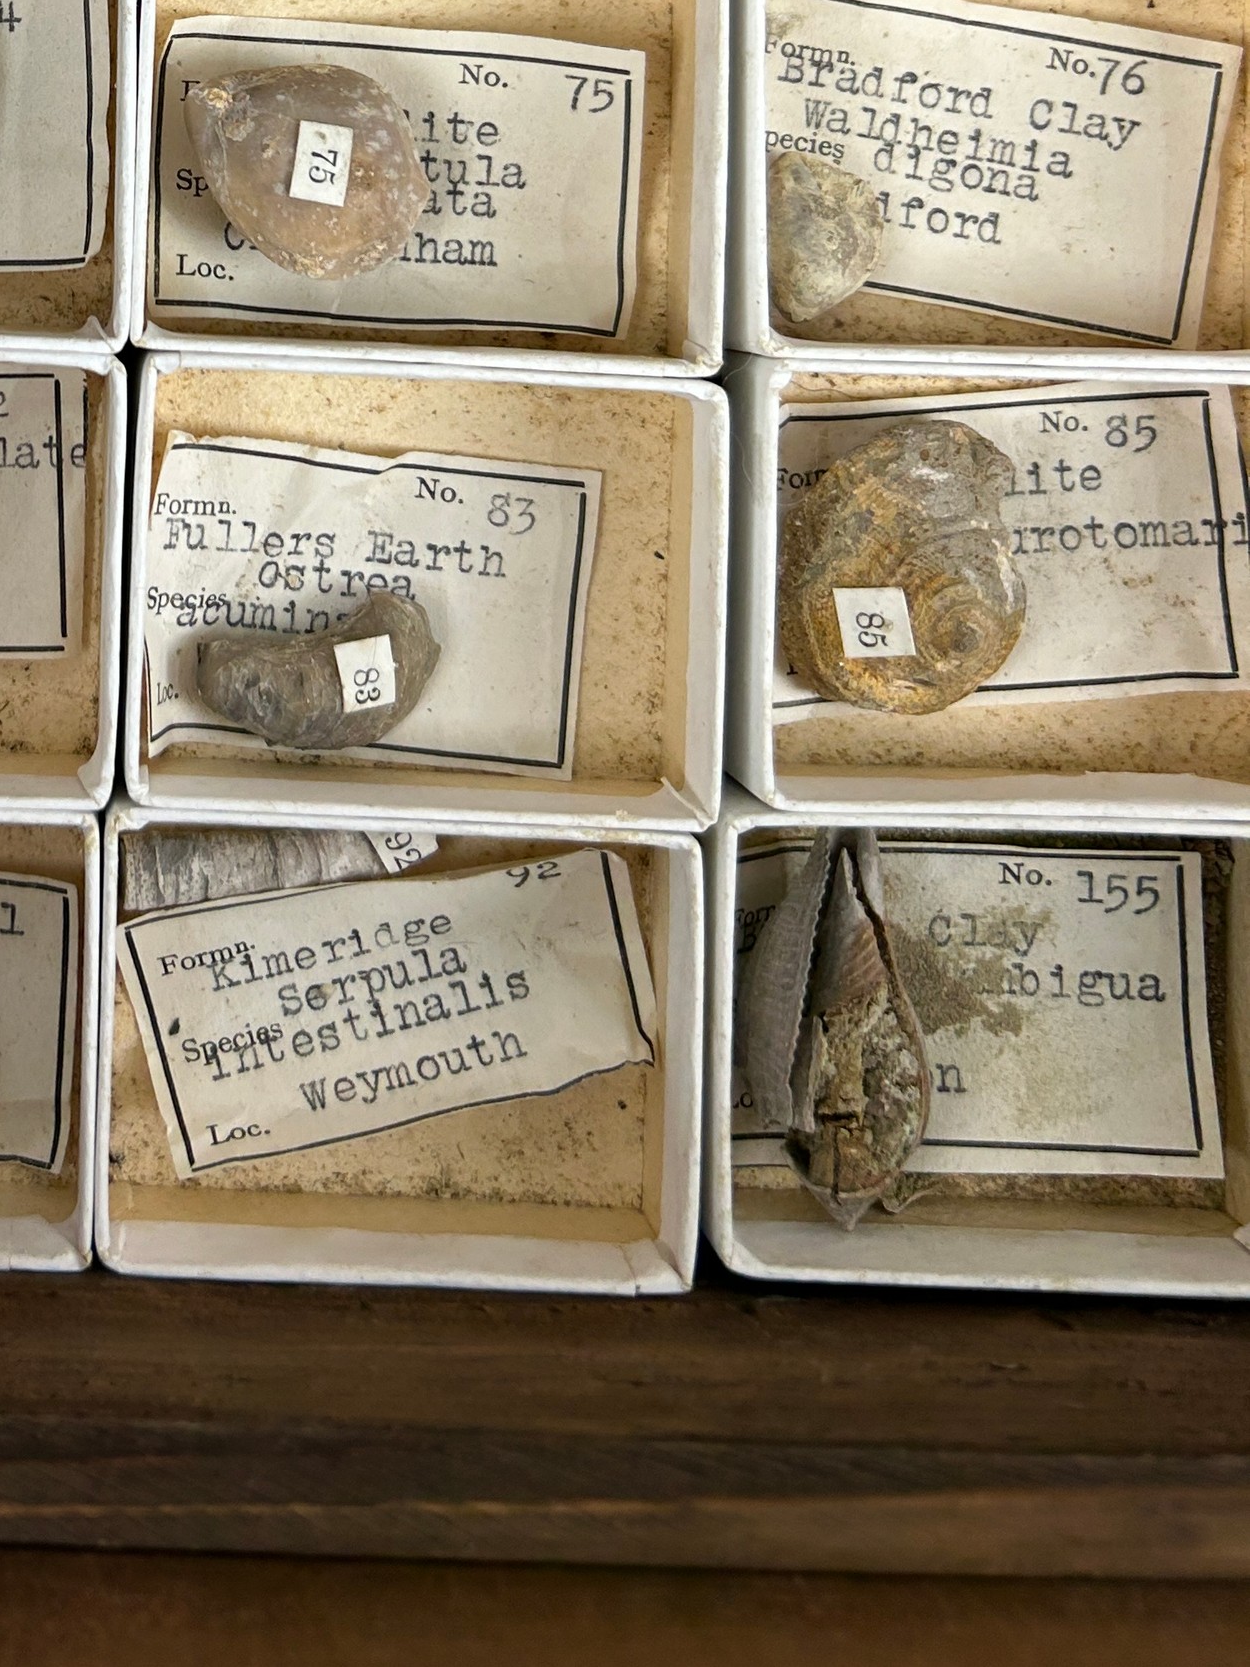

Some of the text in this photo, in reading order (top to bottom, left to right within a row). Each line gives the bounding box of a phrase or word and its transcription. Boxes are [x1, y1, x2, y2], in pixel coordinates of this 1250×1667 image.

[459, 63, 615, 114] No. 75
[777, 55, 1143, 151] Bradford Clay
[765, 128, 845, 159] pecies
[803, 97, 1075, 179] Waldheimia
[307, 149, 339, 185] 75
[874, 143, 1040, 203] digona
[176, 254, 234, 281] Loc.
[1039, 410, 1157, 452] No. 85
[414, 477, 536, 535] No. 83
[163, 517, 507, 579] Fullers Earth
[855, 610, 888, 648] 85
[157, 681, 179, 706] Loc.
[352, 667, 382, 705] 83
[998, 862, 1161, 915] No. 155
[208, 911, 453, 993] Kimeridge
[277, 944, 469, 1018] Serpula
[299, 1029, 529, 1113] Weymouth
[207, 1121, 271, 1147] Loc.
